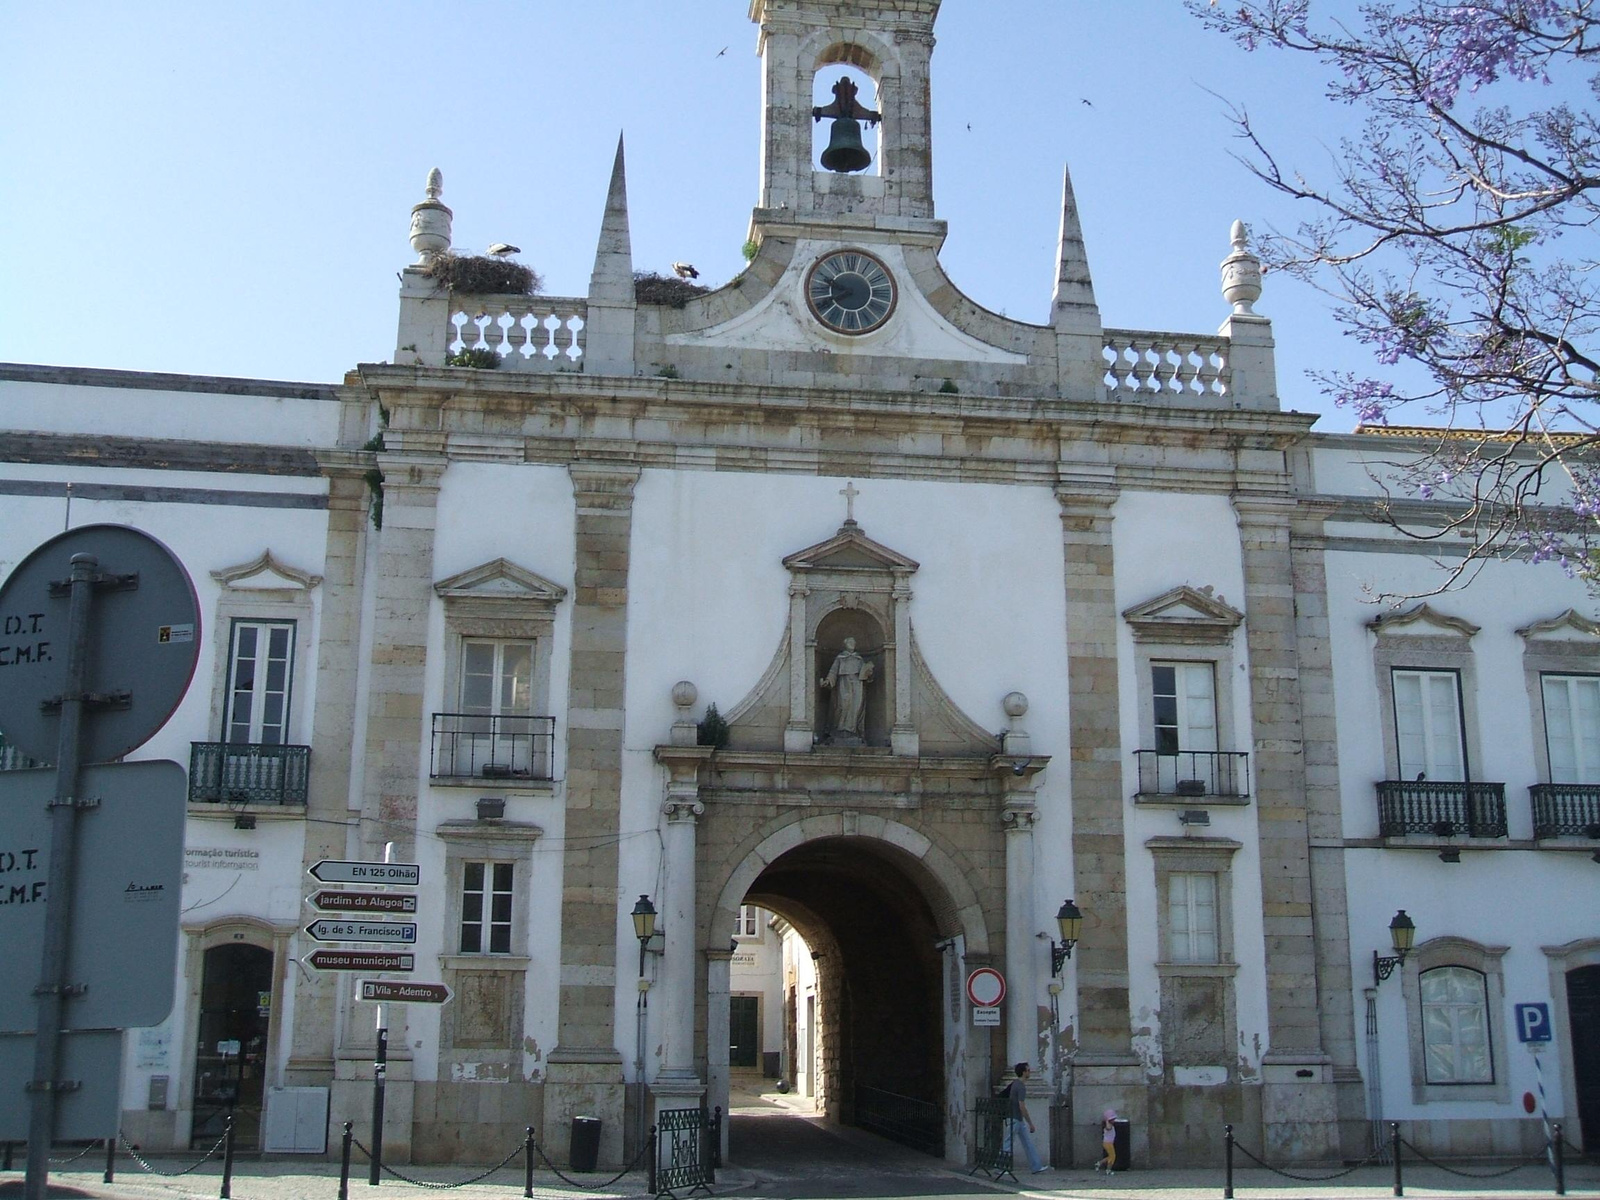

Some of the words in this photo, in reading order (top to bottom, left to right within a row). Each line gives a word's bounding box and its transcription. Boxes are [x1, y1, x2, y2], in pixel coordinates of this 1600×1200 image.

[5, 613, 45, 635] D.T.
[183, 849, 223, 858] ormação
[225, 849, 259, 858] turística
[212, 860, 259, 869] information
[352, 867, 366, 876] EN
[370, 868, 385, 877] 125
[388, 869, 416, 878] Olhão
[320, 895, 352, 905] jardim
[355, 897, 367, 905] da
[369, 898, 403, 908] Alagoa
[332, 926, 343, 934] de
[347, 926, 356, 934] S.
[359, 926, 401, 936] Francisco
[403, 928, 411, 938] P
[317, 956, 349, 964] museu
[352, 956, 400, 967] municipal
[375, 985, 391, 994] Vila
[399, 986, 432, 997] Adentro
[1522, 1007, 1542, 1038] P
